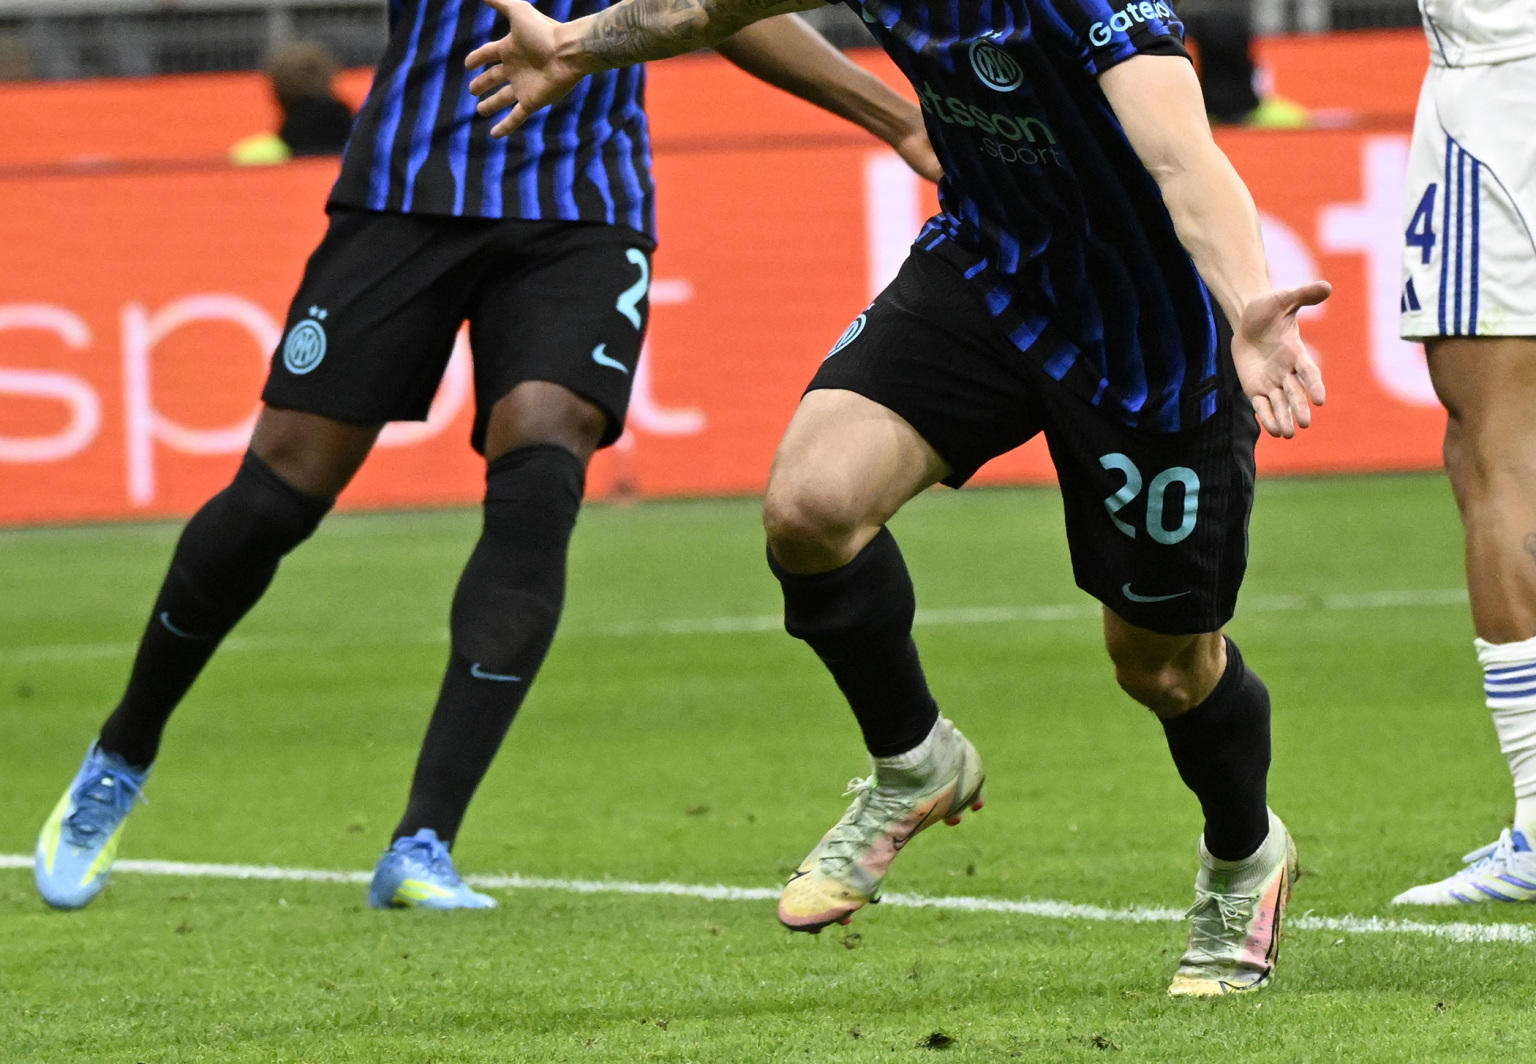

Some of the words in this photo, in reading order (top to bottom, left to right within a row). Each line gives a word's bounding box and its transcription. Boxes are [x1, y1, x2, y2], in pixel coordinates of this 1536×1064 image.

[916, 80, 1057, 145] etsson
[1405, 183, 1438, 265] 4
[616, 247, 649, 331] 2
[1098, 452, 1201, 545] 20
